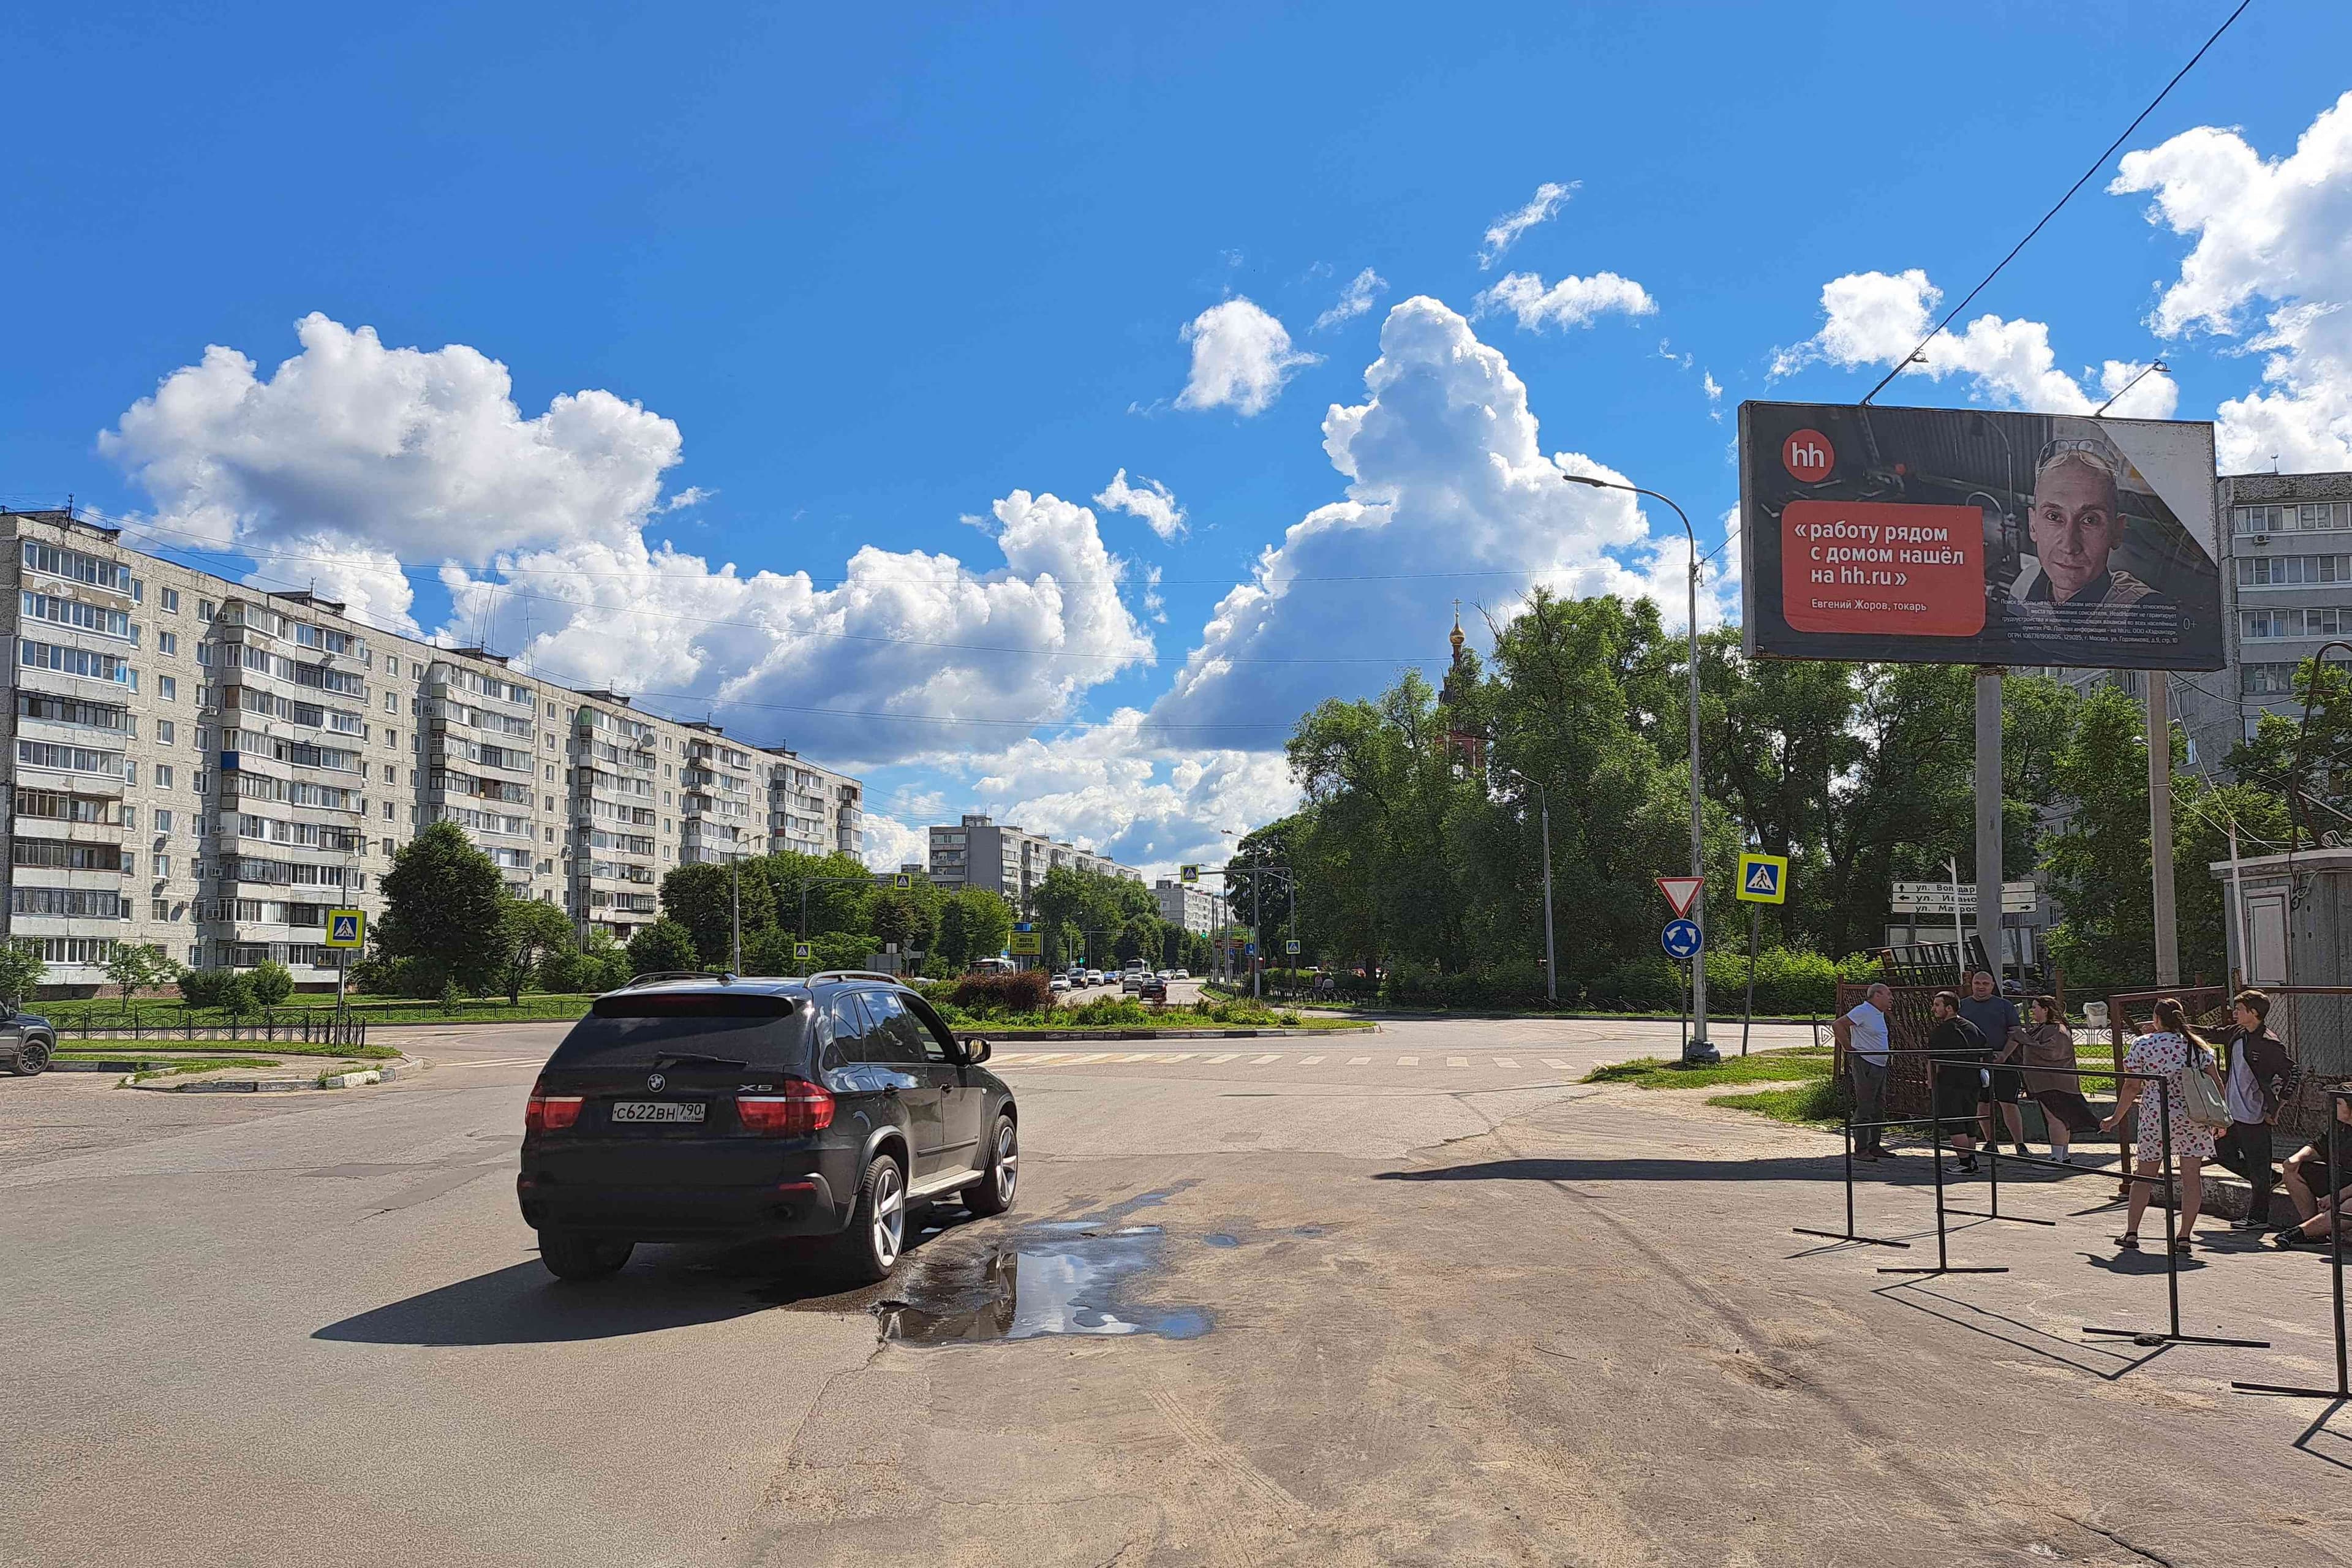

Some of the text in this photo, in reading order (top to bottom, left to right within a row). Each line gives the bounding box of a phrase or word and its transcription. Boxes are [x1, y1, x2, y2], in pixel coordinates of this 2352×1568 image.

[1792, 441, 1825, 467] hh
[1794, 521, 1948, 544] «работу рядом
[1811, 546, 1964, 565] с домом нашёл
[1811, 566, 1907, 586] на hh.ru»
[1811, 598, 1927, 613] Евгений Жоров, токарь
[2183, 618, 2198, 630] 0+
[680, 1104, 702, 1116] 790
